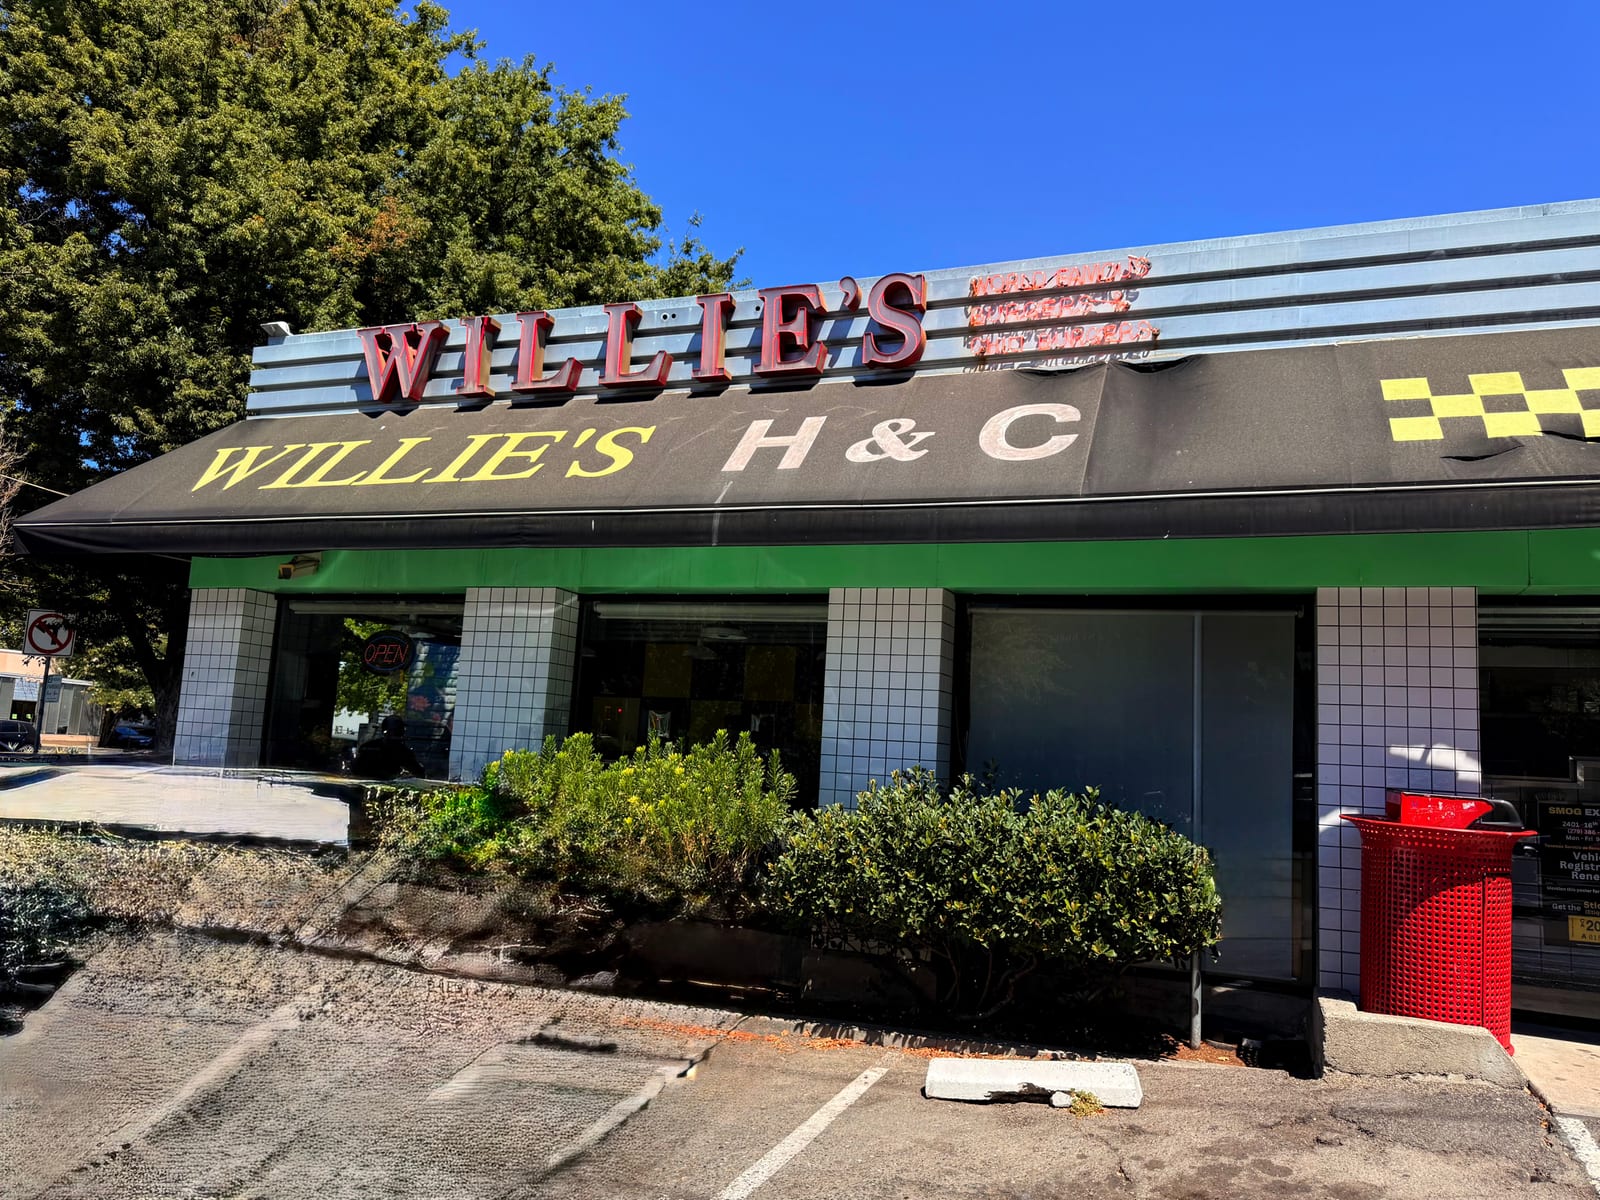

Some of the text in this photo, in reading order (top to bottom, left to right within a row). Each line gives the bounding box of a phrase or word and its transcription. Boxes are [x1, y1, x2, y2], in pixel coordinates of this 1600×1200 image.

[356, 272, 928, 402] WILLIE'S
[721, 403, 1082, 472] H & C
[191, 425, 656, 492] WILLIE'S
[364, 643, 409, 663] OPEN
[1548, 806, 1582, 815] SMOG
[1572, 851, 1600, 862] Vehi
[1571, 871, 1600, 881] Rene
[1567, 903, 1582, 911] the
